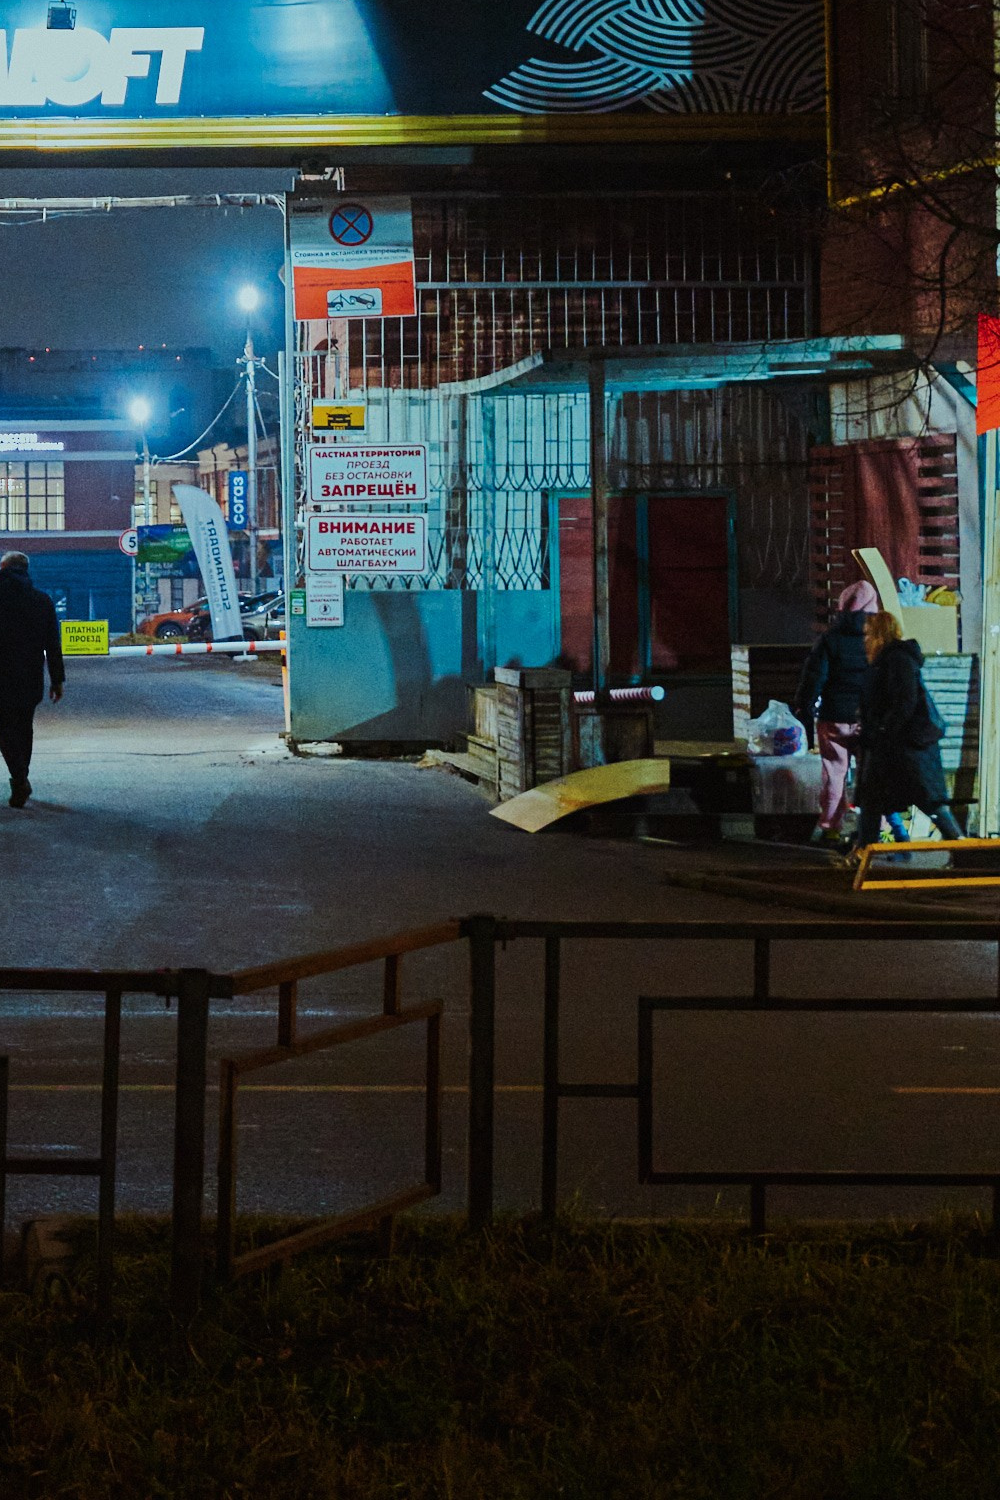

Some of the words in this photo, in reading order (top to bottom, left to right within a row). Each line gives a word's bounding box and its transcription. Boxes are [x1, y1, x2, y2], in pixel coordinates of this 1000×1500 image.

[346, 460, 390, 469] ПРОЕЗД
[325, 472, 344, 480] БЕЗ
[347, 471, 412, 480] ОСТАНОВКИ
[321, 480, 416, 497] ЗАПРЕЩЁН
[318, 522, 416, 534] ВНИМАНИЕ
[129, 537, 136, 548] 5
[340, 538, 393, 546] РАБОТАЕТ
[317, 547, 416, 556] АВТОМАТИЧЕСКИЙ
[65, 625, 105, 634] ПЛАТНЫЙ
